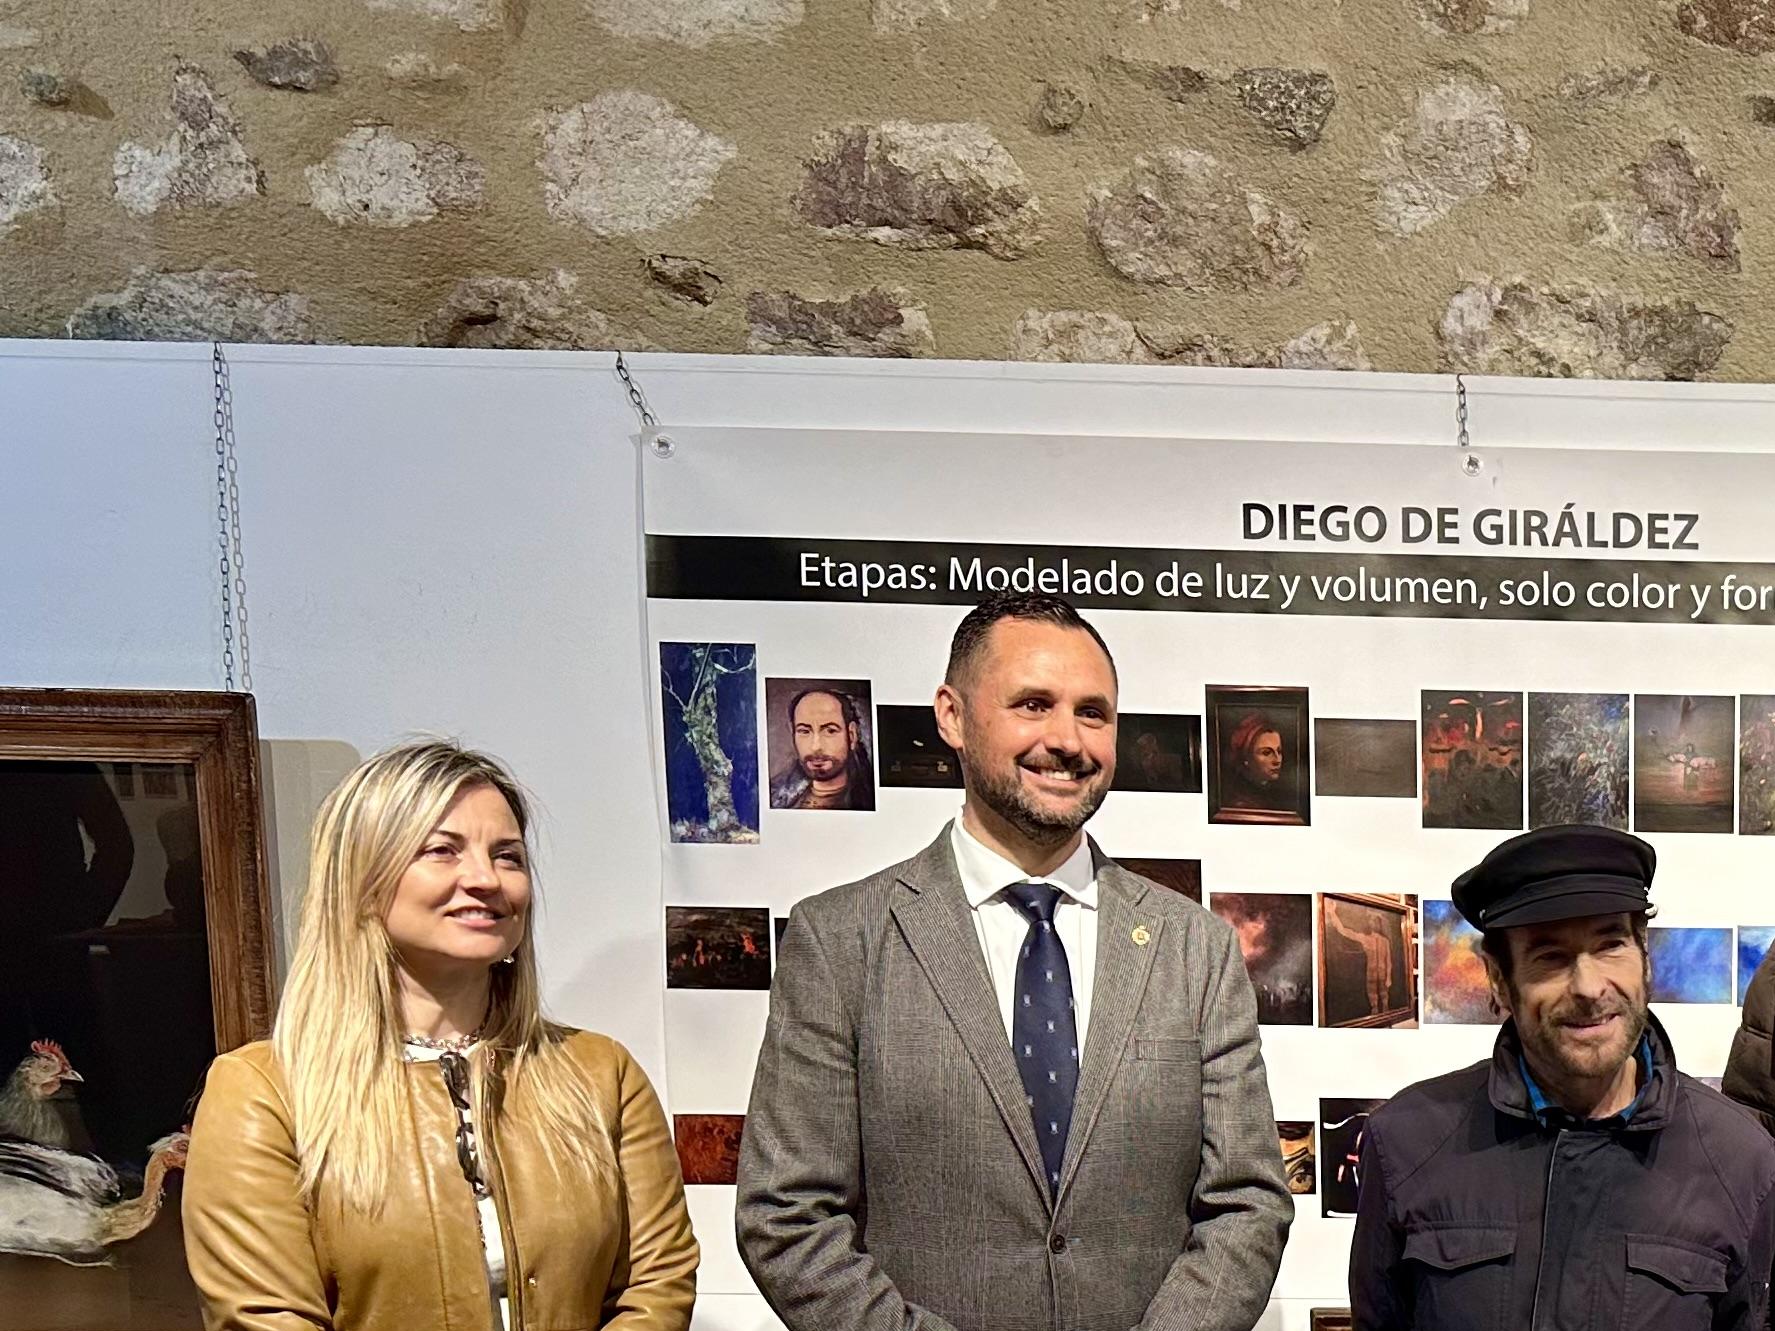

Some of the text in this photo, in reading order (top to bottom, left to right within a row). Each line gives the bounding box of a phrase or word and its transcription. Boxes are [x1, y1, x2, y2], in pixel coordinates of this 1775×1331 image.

[1242, 502, 1700, 551] DIEGO DE GIRÁLDEZ
[799, 552, 938, 598] Etapas:
[948, 556, 1145, 597] Modelado
[1155, 561, 1202, 599] de
[1214, 562, 1271, 600] luz
[1279, 574, 1301, 610] y
[1310, 566, 1489, 610] volumen,
[1499, 570, 1577, 608] solo
[1585, 572, 1681, 610] color
[1689, 583, 1712, 619] y
